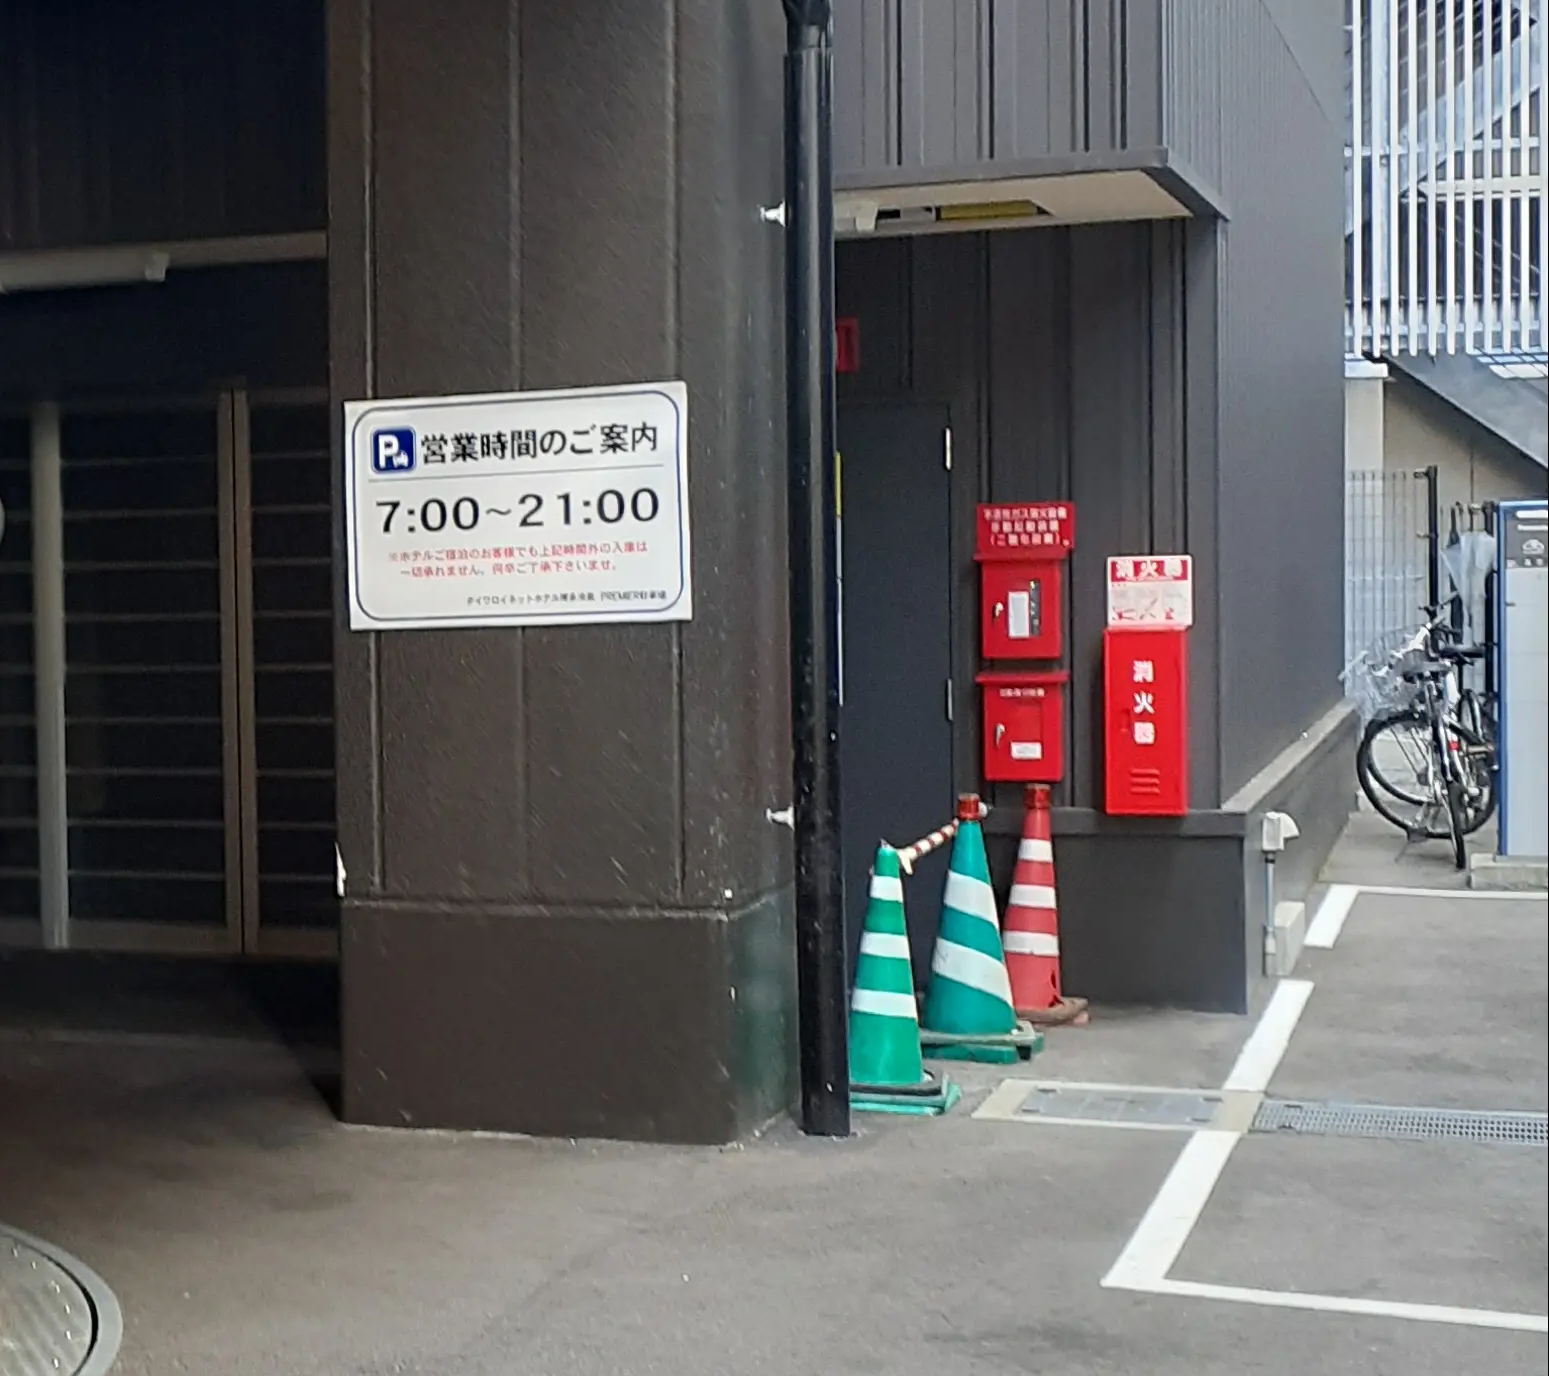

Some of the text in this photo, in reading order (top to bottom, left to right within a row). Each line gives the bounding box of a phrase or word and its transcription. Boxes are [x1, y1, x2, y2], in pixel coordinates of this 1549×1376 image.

[420, 422, 658, 465] 営業時間のご案内
[1116, 558, 1182, 580] 消火器
[1133, 659, 1155, 745] 消火器
